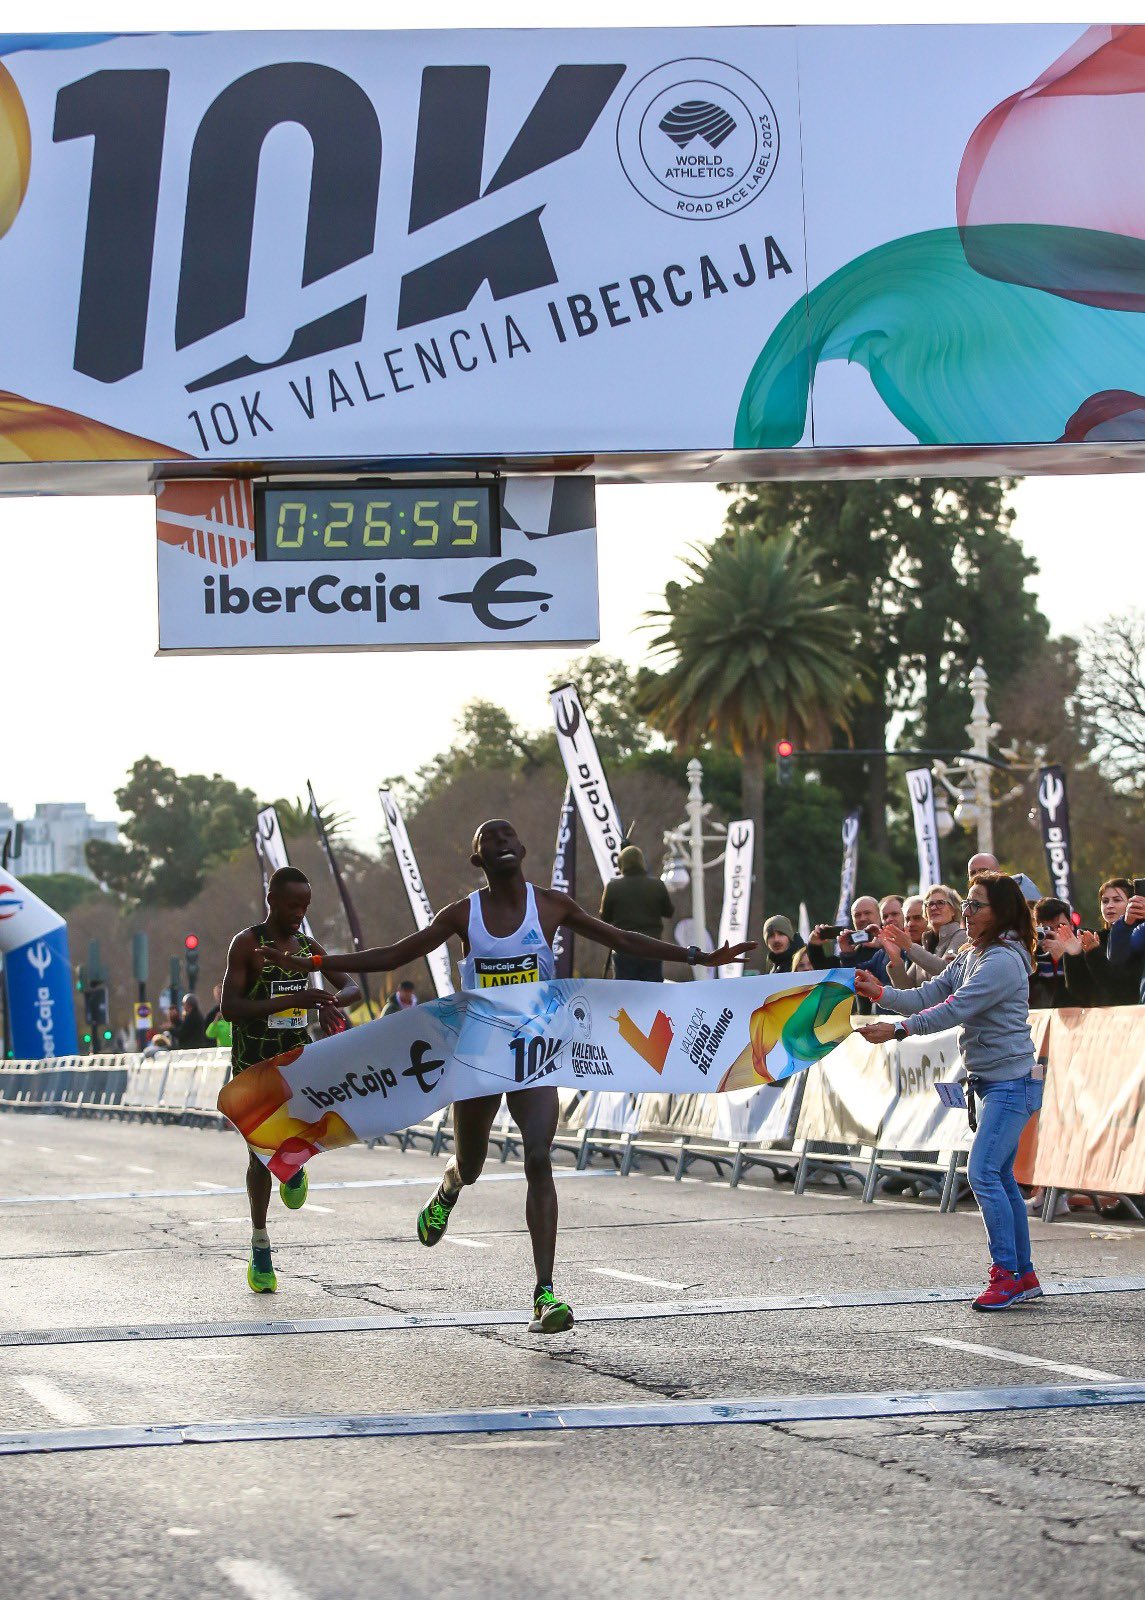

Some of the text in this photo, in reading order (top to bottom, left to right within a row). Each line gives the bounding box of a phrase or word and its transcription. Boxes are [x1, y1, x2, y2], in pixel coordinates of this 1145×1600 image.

[665, 167, 734, 178] ATHLETICS
[676, 155, 723, 166] WORLD
[676, 114, 773, 213] ROAD RACE LABEL 2023
[52, 61, 627, 393] 10K
[187, 235, 794, 452] 10K VALENCIA IBERCAJA
[276, 500, 479, 548] 0:26:55
[203, 572, 420, 622] iberCaja
[480, 962, 515, 971] iberCaja
[33, 987, 56, 1057] erCaja
[680, 1007, 707, 1055] VALENCIA
[689, 1023, 712, 1065] CIUDAD
[697, 1007, 734, 1076] DEL RUNNING
[508, 1035, 563, 1085] 10K
[571, 1041, 608, 1061] VALENCIA
[571, 1058, 614, 1077] IBERCAJA
[301, 1064, 398, 1110] iberCaja
